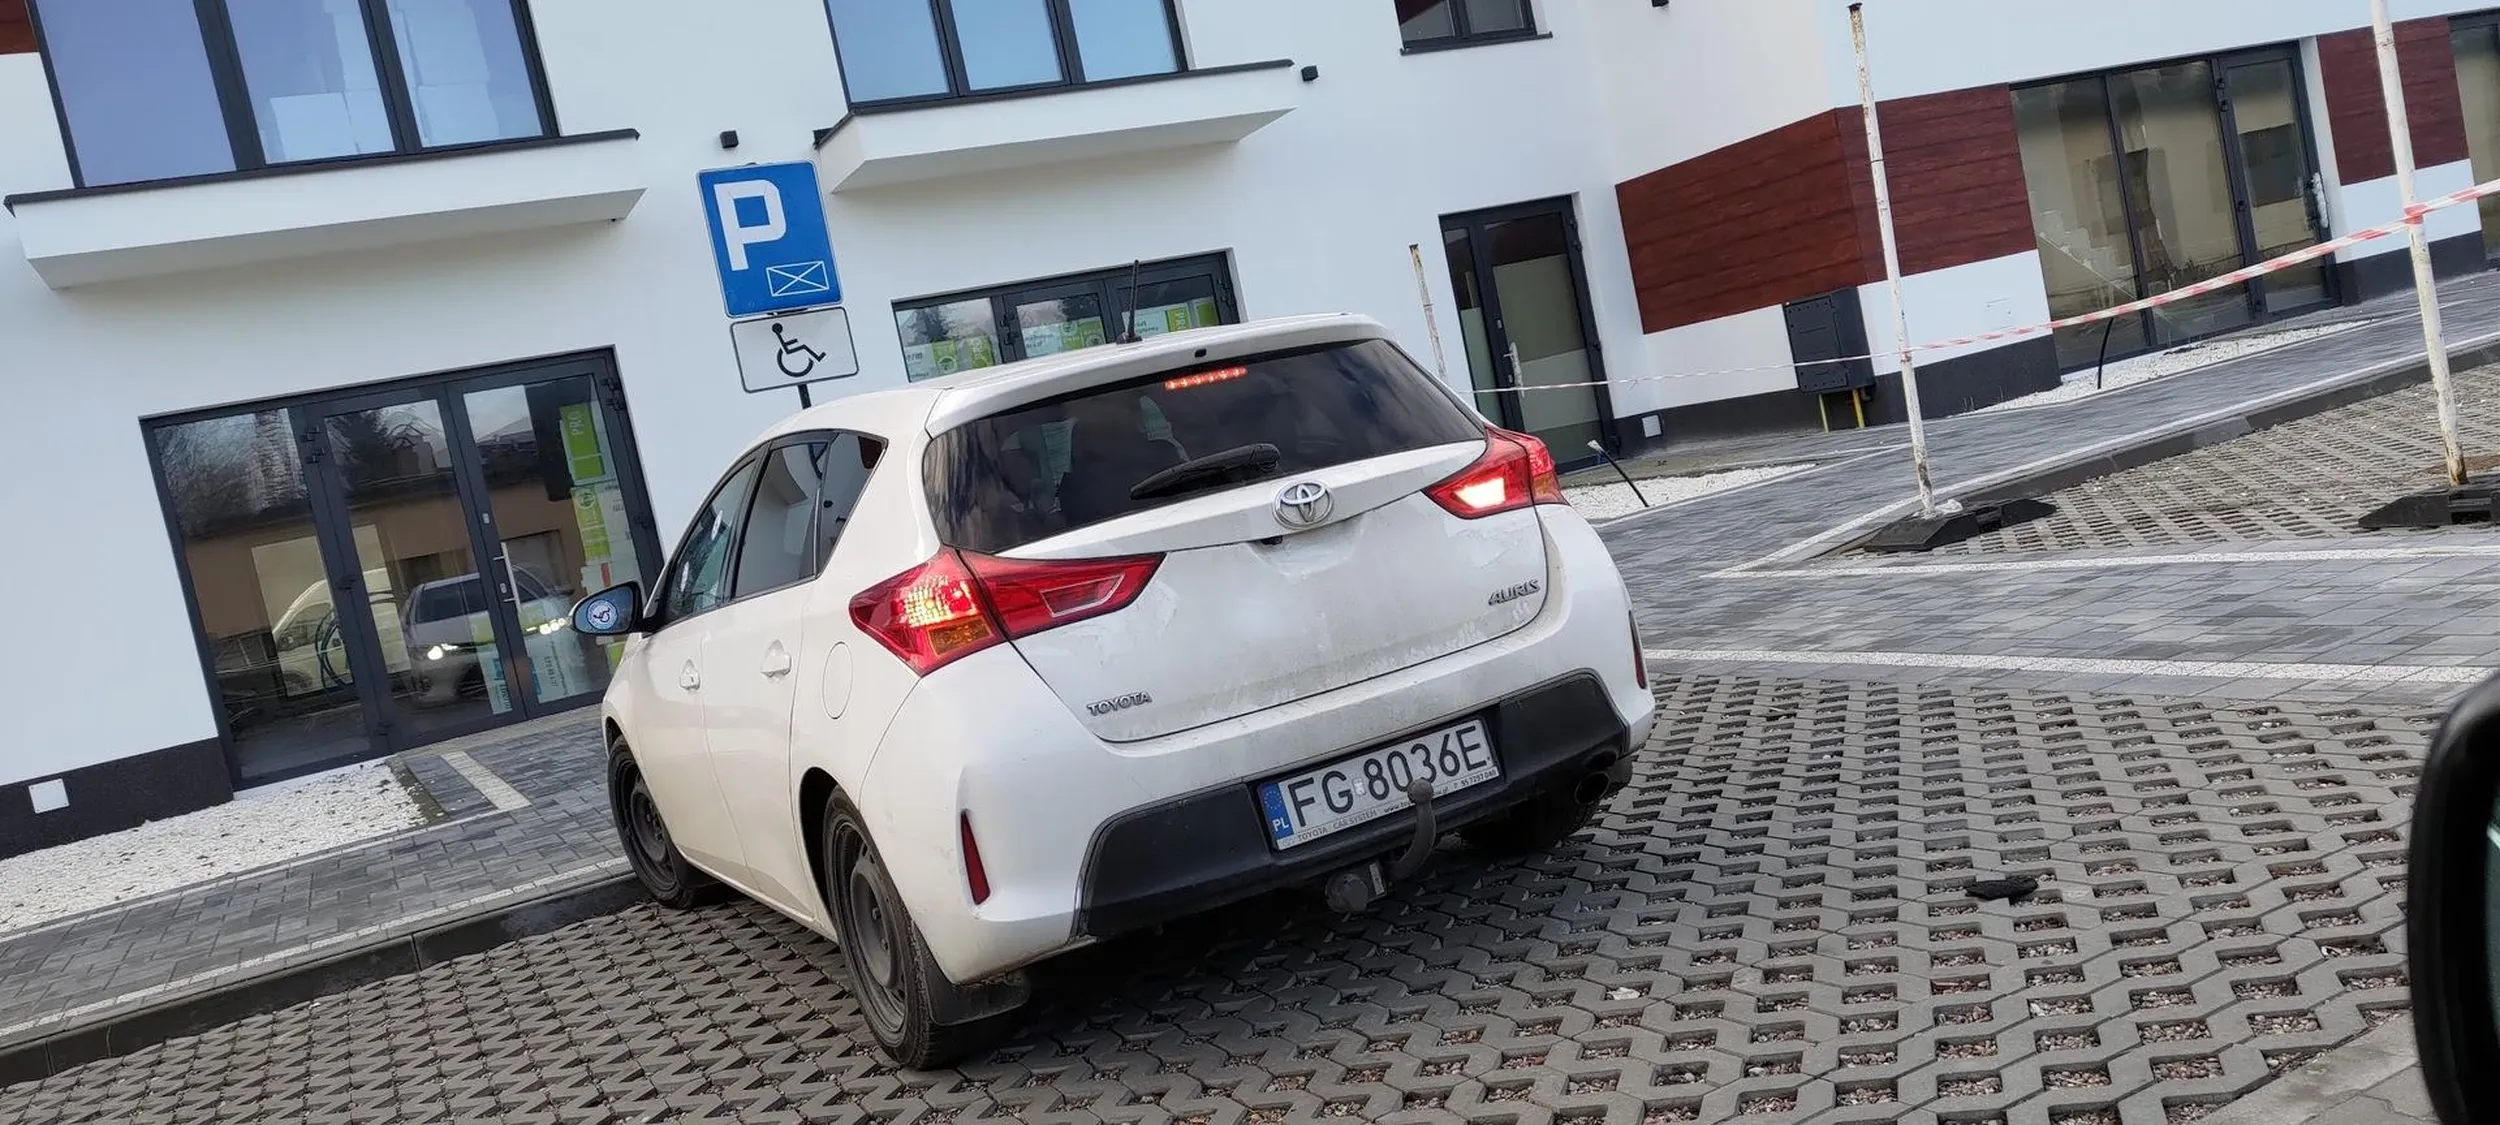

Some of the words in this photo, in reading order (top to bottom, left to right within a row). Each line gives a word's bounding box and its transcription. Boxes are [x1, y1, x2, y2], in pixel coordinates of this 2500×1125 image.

[714, 179, 787, 271] P
[1487, 579, 1541, 606] AURIS
[1086, 691, 1153, 716] TOYOTA
[1287, 770, 1354, 828] FG
[1363, 725, 1487, 800] 8036E
[1272, 817, 1290, 832] PL
[1298, 826, 1329, 842] TOYOTA
